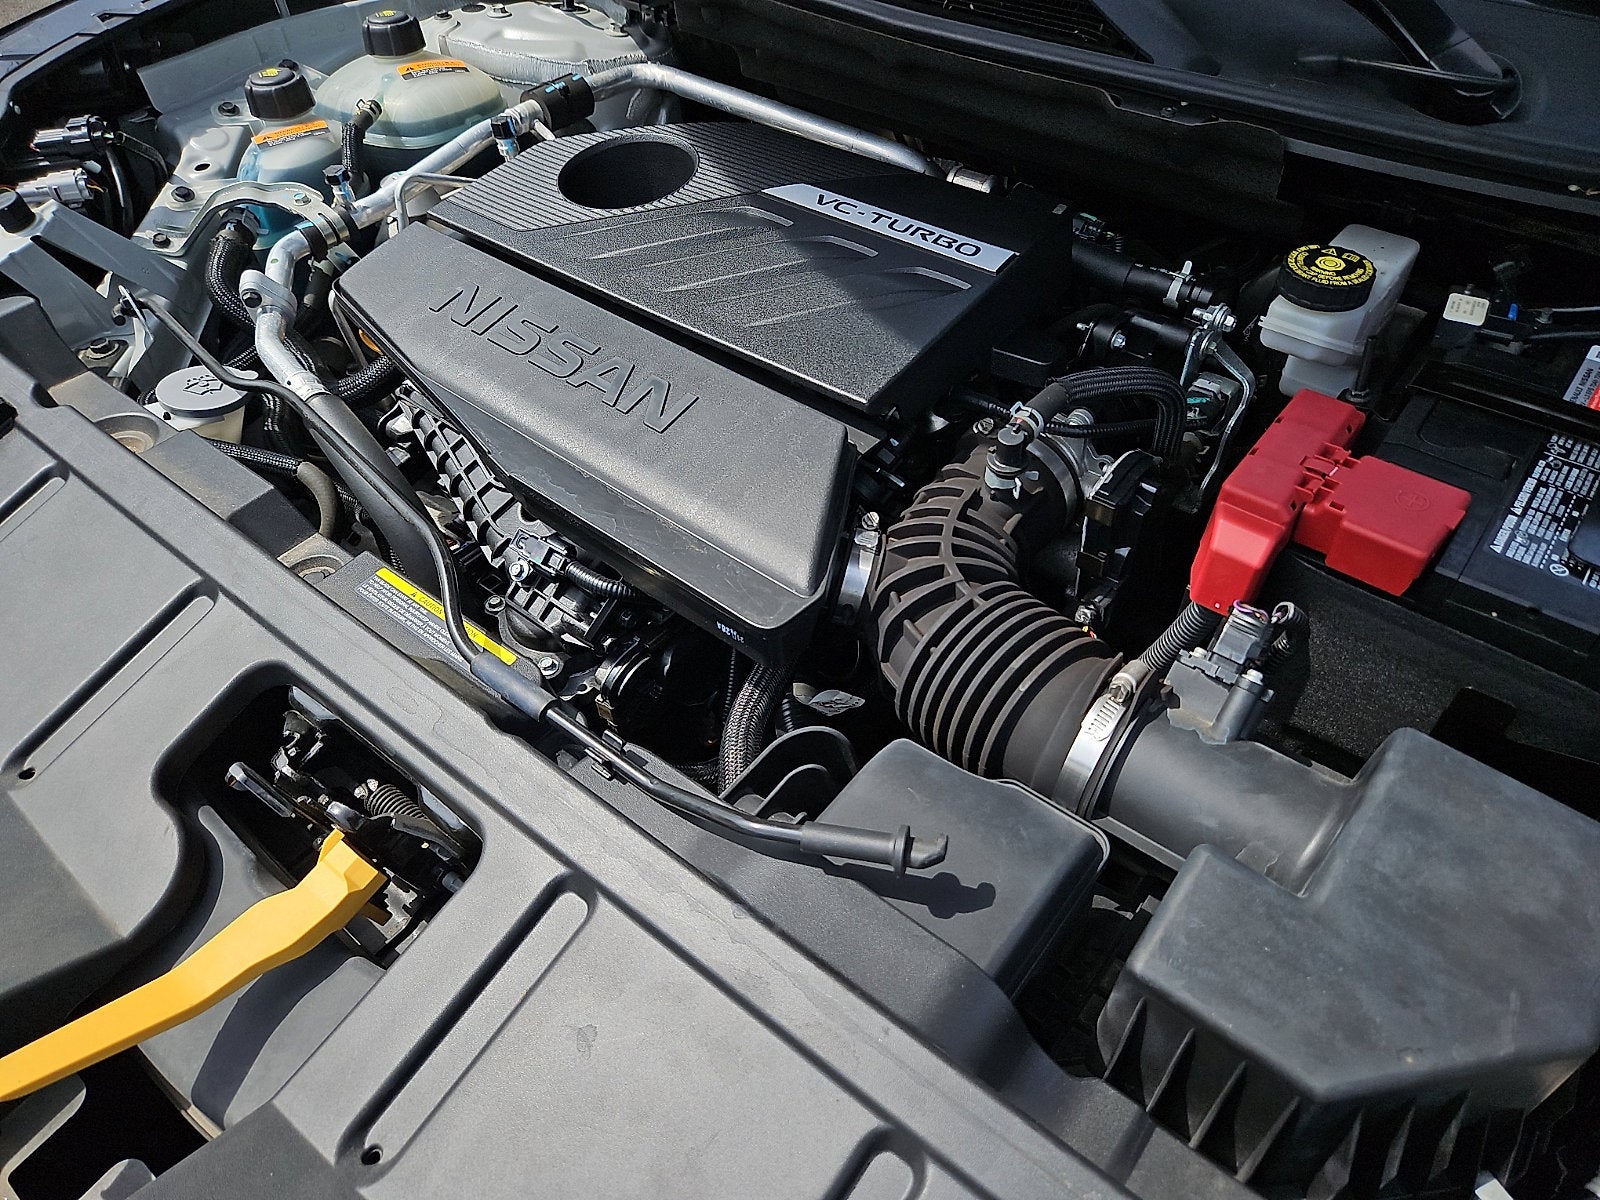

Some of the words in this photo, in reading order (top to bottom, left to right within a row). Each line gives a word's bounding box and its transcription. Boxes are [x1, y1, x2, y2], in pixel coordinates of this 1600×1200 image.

[816, 194, 982, 257] VC-TURBO
[429, 281, 700, 434] NISSAN
[418, 596, 443, 615] CAUTION
